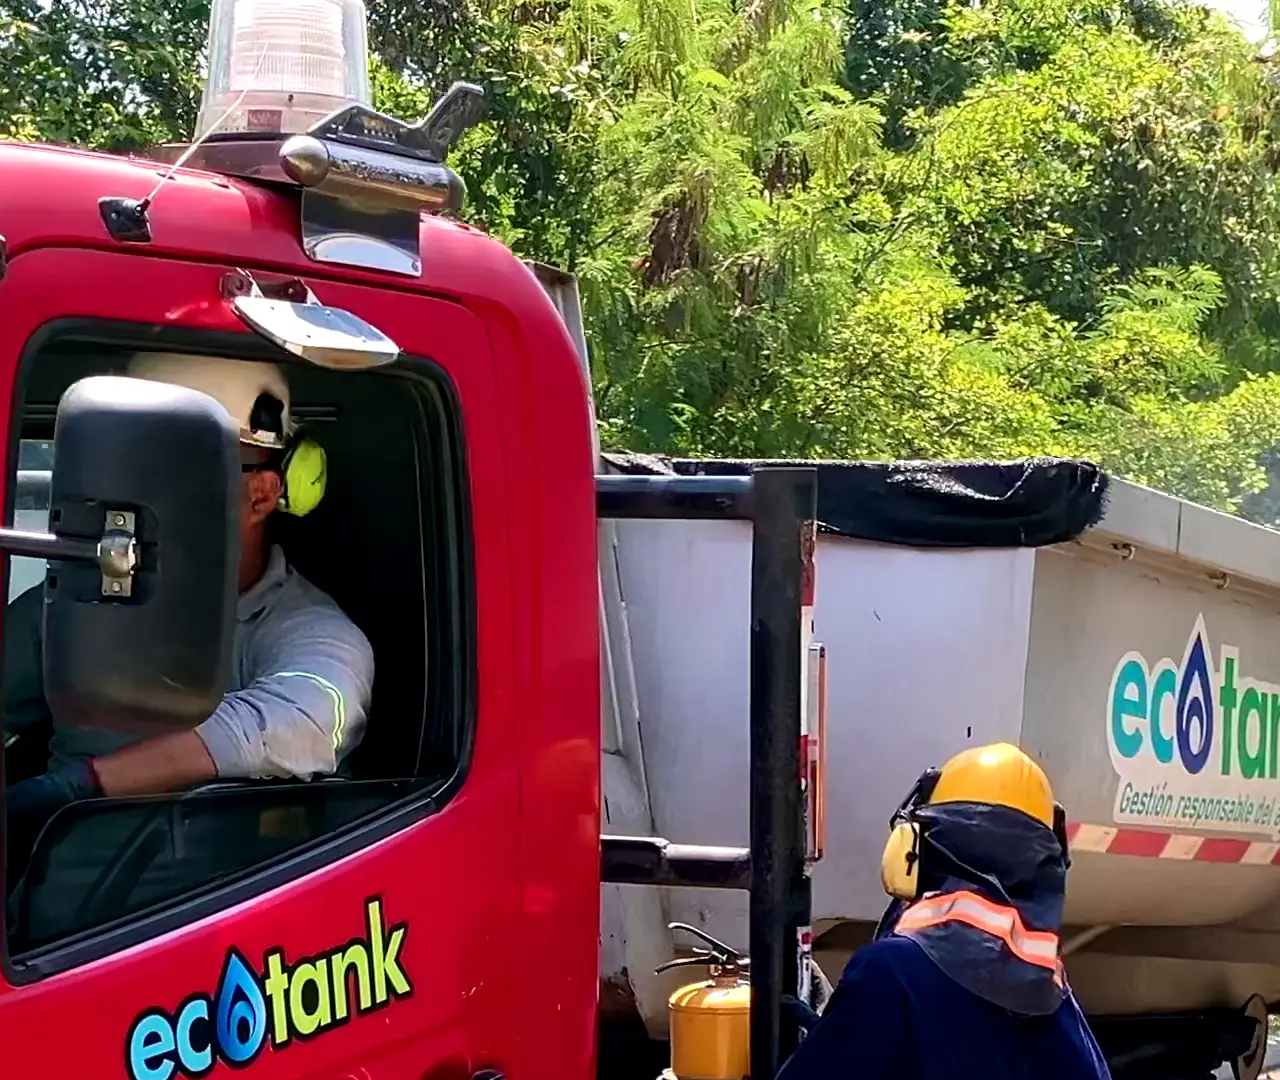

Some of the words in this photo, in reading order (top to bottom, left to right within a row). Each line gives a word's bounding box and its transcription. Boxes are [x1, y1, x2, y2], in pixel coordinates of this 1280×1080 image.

[1119, 782, 1173, 818] Gestión
[1174, 793, 1255, 825] responsable
[1254, 797, 1275, 826] del
